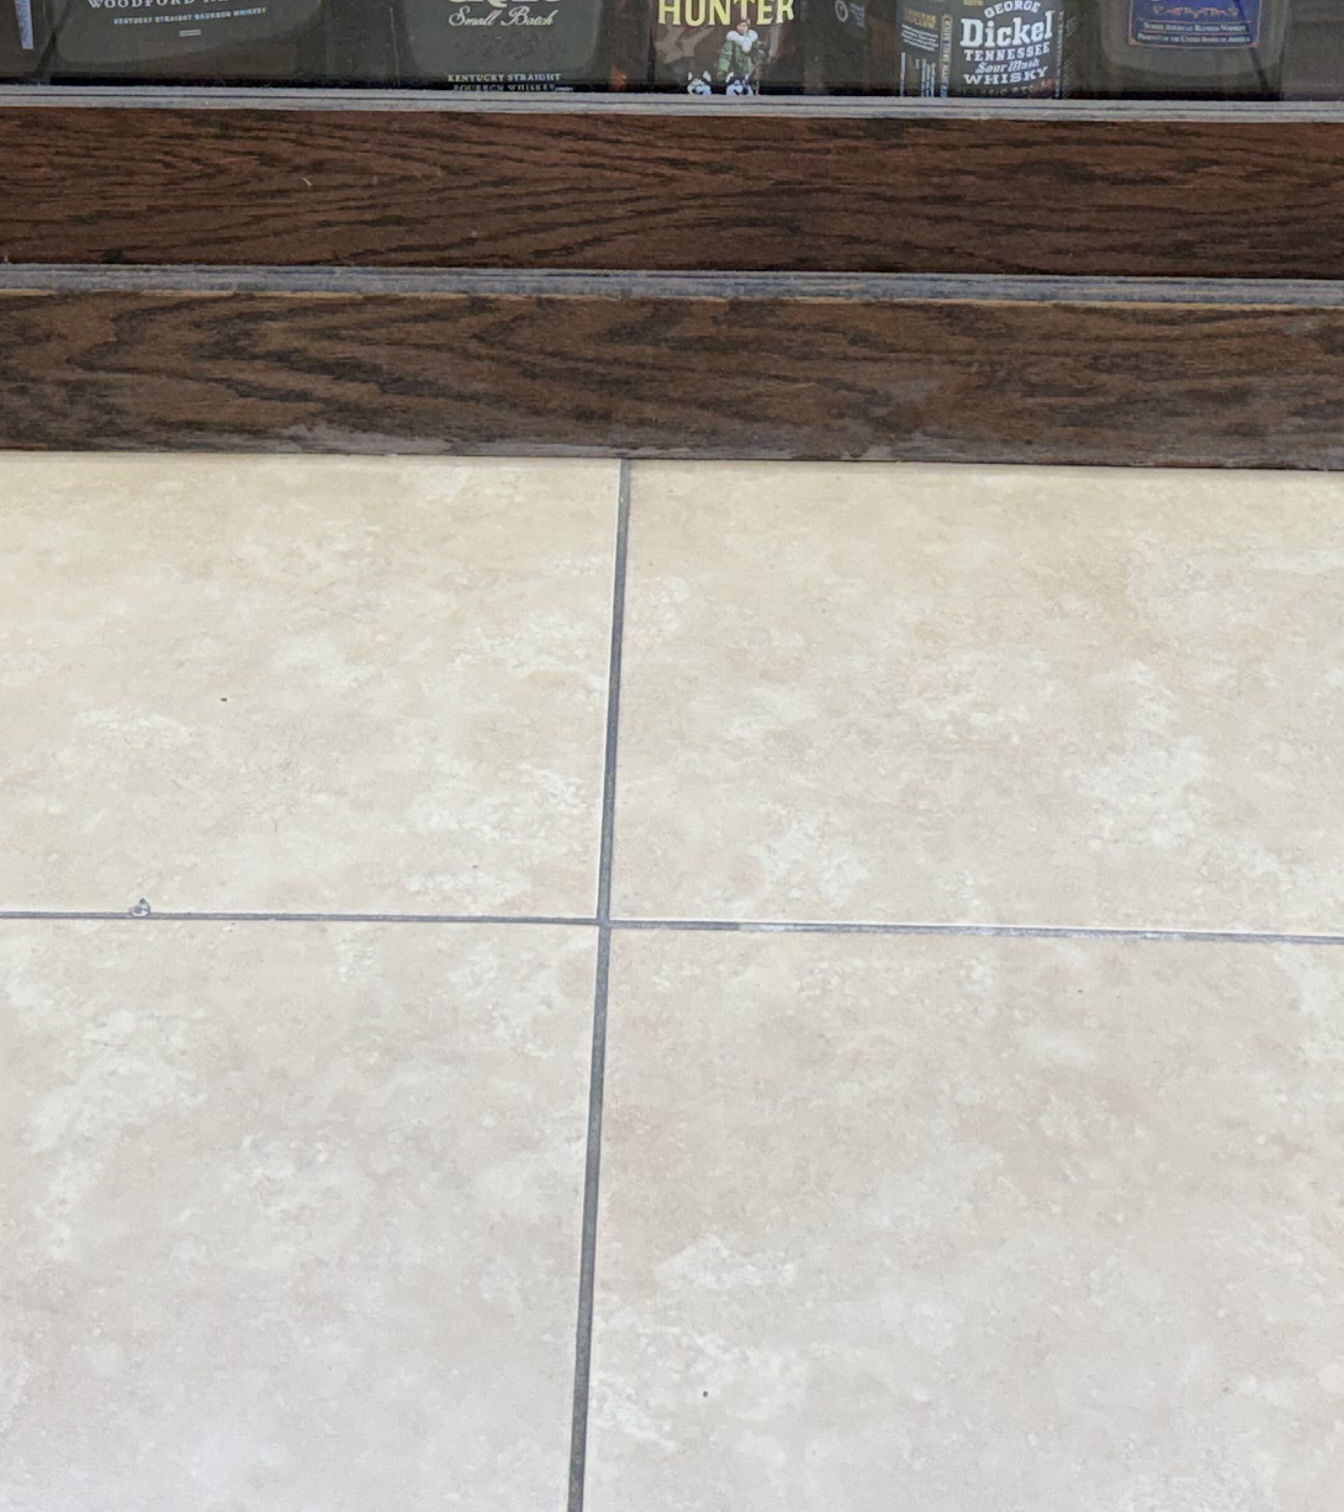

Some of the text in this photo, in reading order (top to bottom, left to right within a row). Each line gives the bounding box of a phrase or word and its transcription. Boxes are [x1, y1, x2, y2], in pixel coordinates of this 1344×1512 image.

[448, 5, 559, 27] Small Batch
[959, 9, 1055, 48] Dickel
[963, 41, 1052, 62] TENNESSEE
[962, 66, 1049, 86] WHISKY
[974, 57, 1041, 75] Sour Mash
[447, 72, 562, 83] KENTUCKY STRAIGHT
